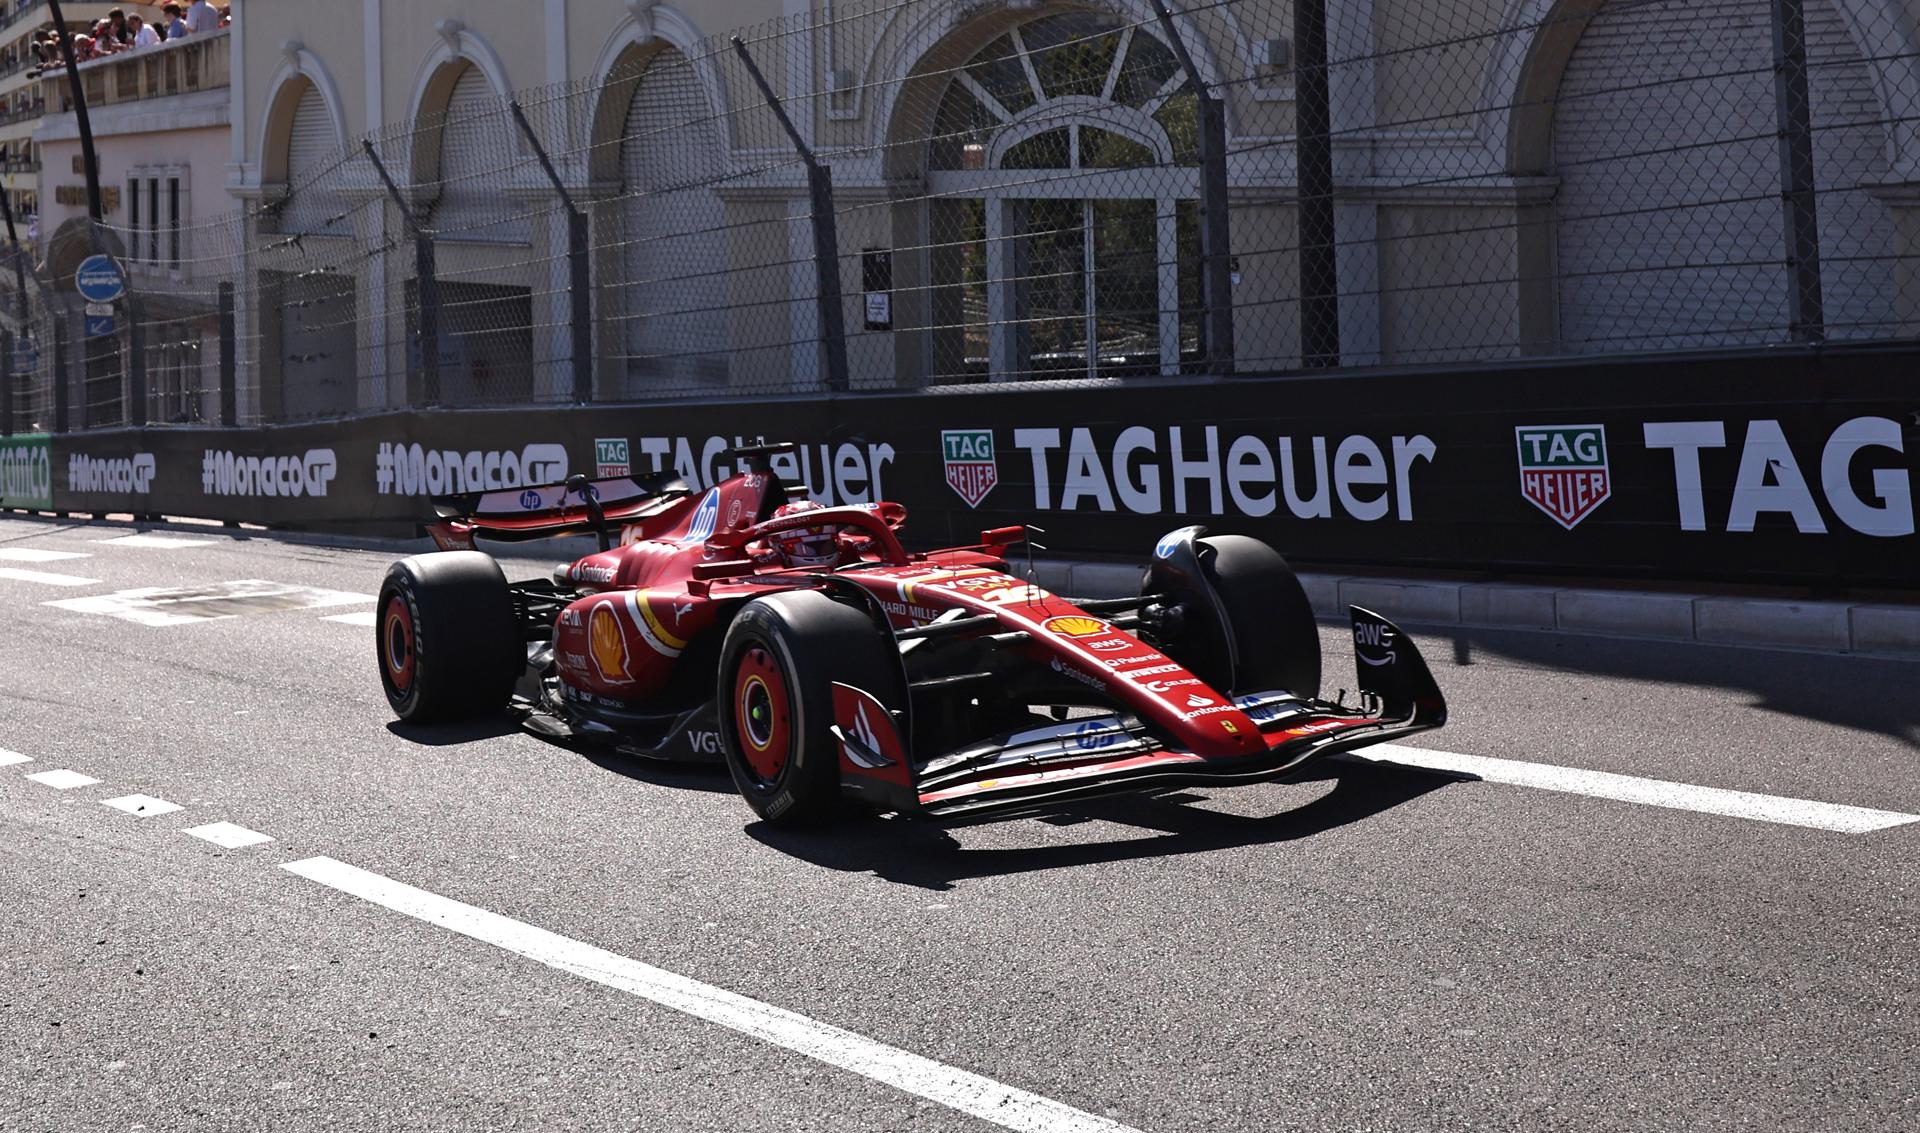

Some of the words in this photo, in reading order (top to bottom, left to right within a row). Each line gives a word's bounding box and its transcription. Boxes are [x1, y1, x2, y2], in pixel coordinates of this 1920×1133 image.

[598, 443, 626, 461] TAG
[946, 435, 990, 460] TAG
[1524, 432, 1599, 463] TAG
[947, 464, 996, 501] HEUER
[522, 490, 540, 510] hp
[1525, 471, 1604, 521] HEUER
[1088, 638, 1126, 650] aws
[1354, 622, 1392, 647] aws
[1182, 705, 1240, 722] Santander
